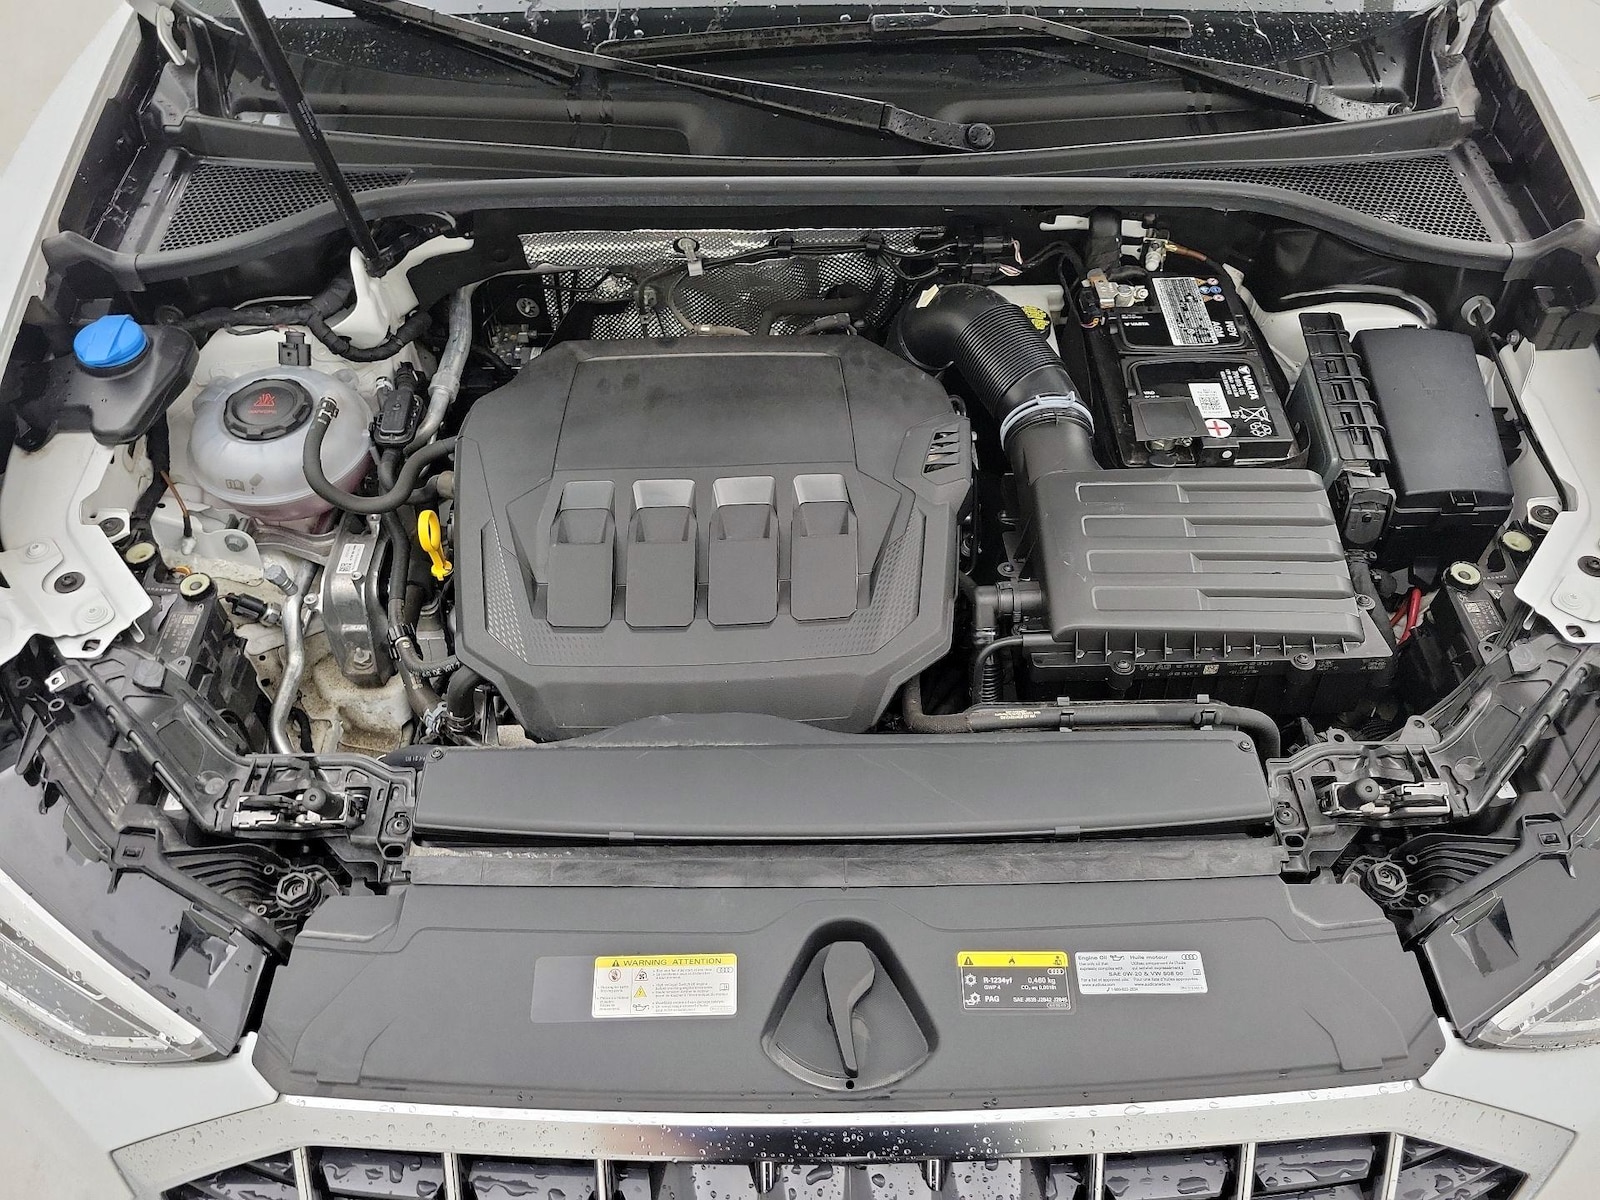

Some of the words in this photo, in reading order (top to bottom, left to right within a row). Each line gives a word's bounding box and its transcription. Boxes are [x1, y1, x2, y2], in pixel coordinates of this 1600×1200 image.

[1211, 320, 1226, 338] AGM
[1242, 374, 1260, 400] VARTA
[1231, 410, 1240, 419] Pb
[623, 959, 667, 967] WARNING
[672, 957, 722, 965] ATTENTION
[983, 976, 1012, 985] R-1234yf
[1047, 976, 1056, 985] kg
